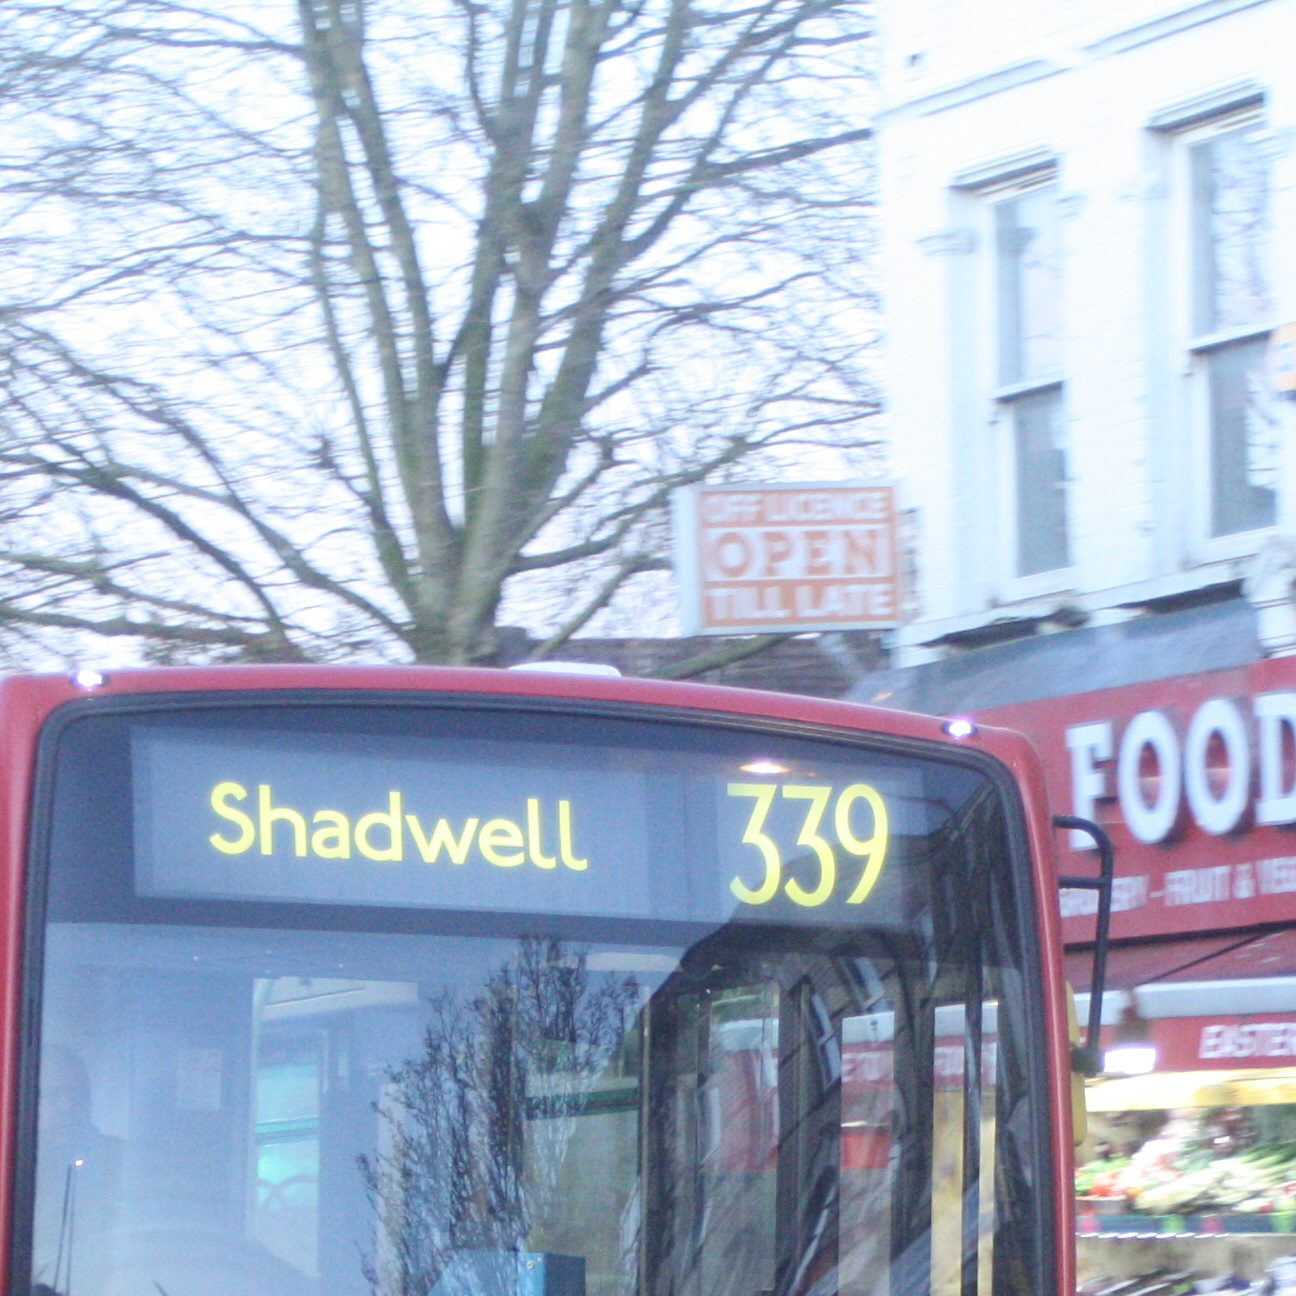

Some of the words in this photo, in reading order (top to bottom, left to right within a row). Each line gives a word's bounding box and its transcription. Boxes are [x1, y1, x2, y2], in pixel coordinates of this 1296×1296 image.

[714, 530, 878, 578] OPEN
[706, 587, 792, 621] TILL
[795, 583, 895, 618] LATE
[207, 780, 589, 873] Shadwell
[726, 781, 890, 909] 339
[1163, 864, 1233, 907] FRUIT
